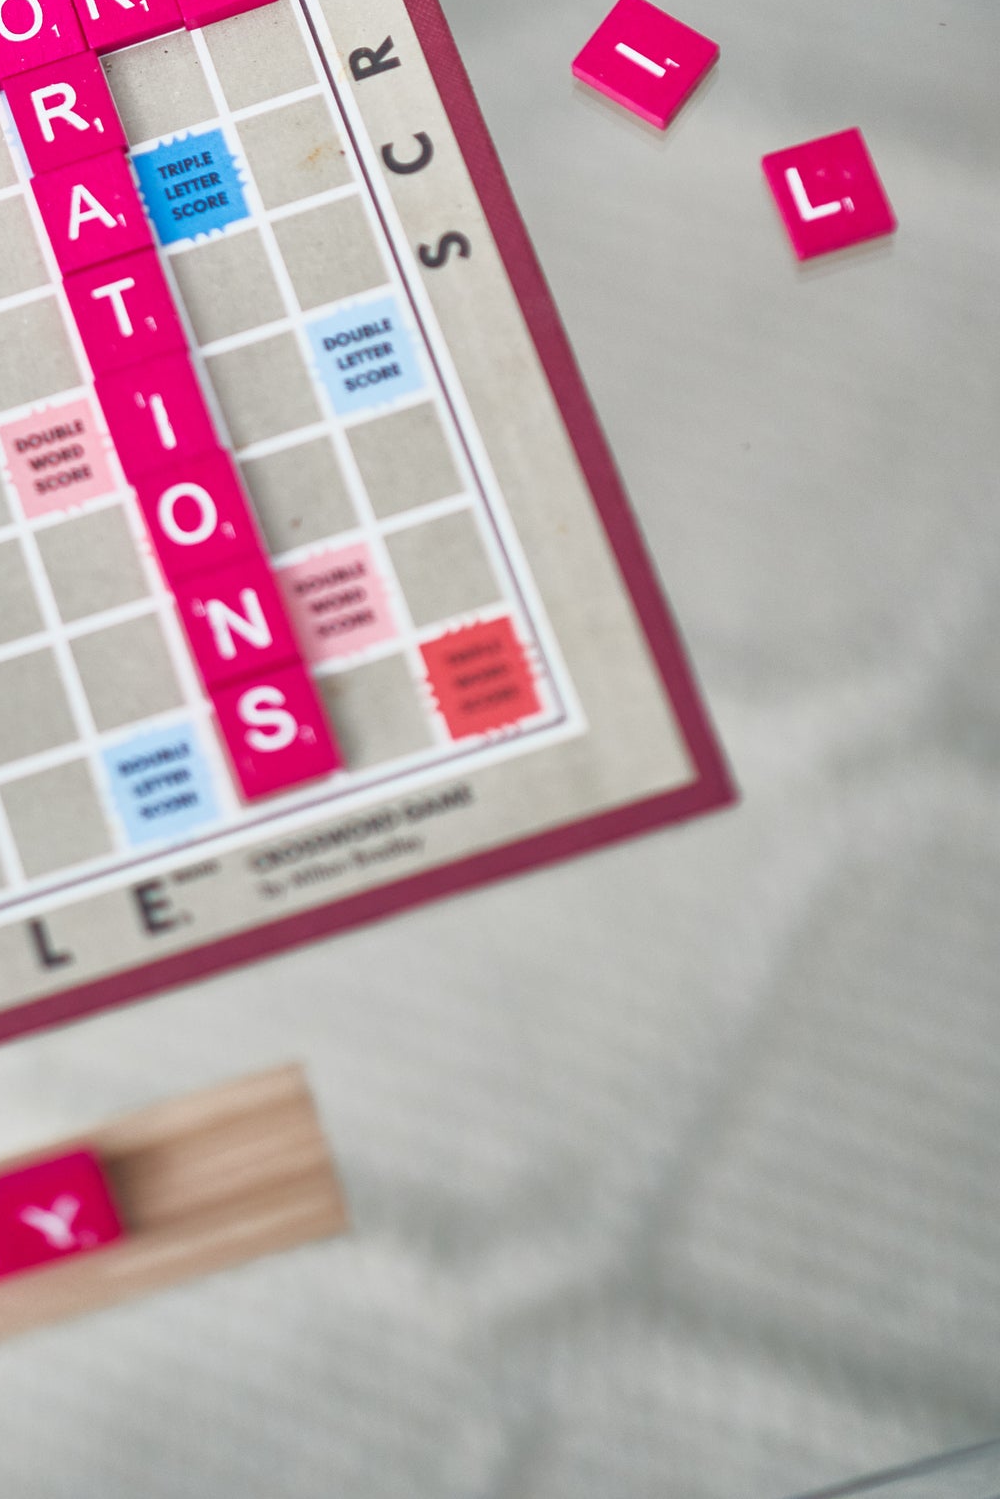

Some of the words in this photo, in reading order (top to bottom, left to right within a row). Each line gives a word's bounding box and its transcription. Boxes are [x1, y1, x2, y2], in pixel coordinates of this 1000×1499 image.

[157, 152, 213, 179] TRIPLE
[164, 172, 221, 201] LETTER
[785, 166, 842, 221] L
[171, 193, 228, 221] SCORE
[323, 319, 391, 351] DOUBLE
[338, 342, 392, 370] LETTER
[345, 364, 400, 391] SCORE
[15, 421, 83, 453] DOUBLE
[29, 446, 83, 471] WORD
[35, 466, 91, 493] SCORE
